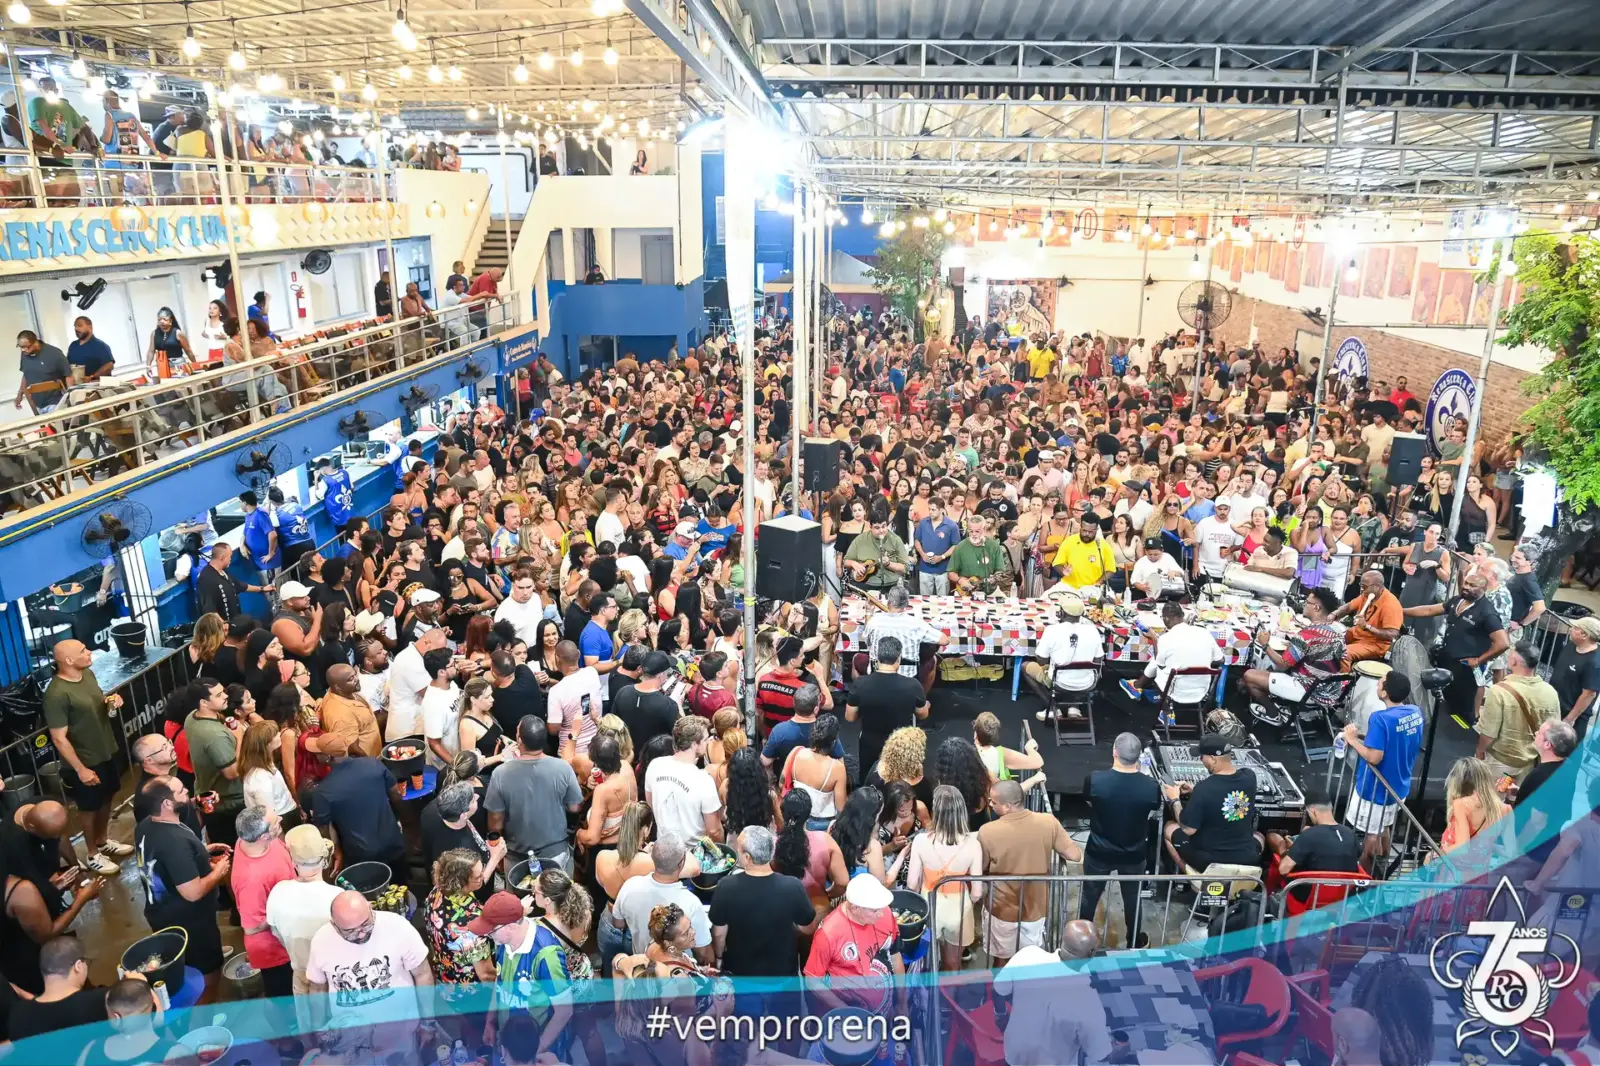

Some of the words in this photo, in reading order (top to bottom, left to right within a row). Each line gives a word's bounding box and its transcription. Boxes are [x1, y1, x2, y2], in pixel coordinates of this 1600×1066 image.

[175, 215, 241, 248] CLUB
[761, 682, 794, 695] PETROBRAS
[1396, 724, 1405, 732] RIO
[1404, 722, 1410, 730] DE
